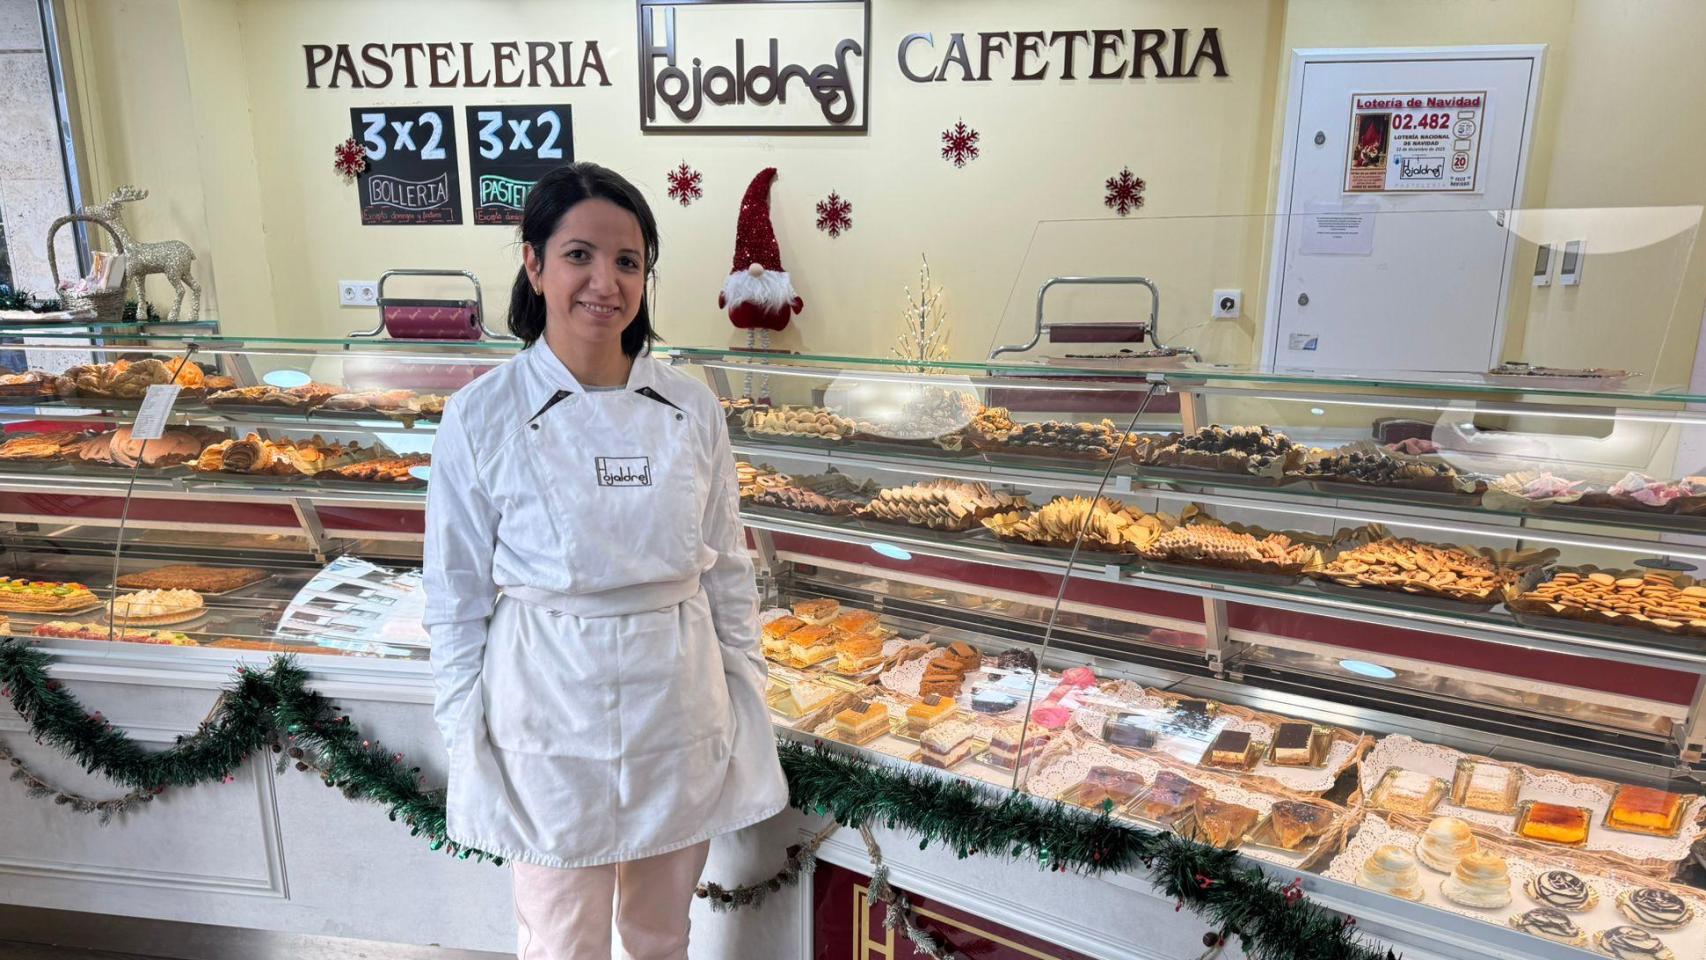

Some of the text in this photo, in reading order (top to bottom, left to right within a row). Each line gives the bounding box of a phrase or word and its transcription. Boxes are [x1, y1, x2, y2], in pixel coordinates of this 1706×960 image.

[302, 40, 613, 89] PASTELERIA
[645, 7, 862, 125] Hojaldres
[898, 27, 1230, 83] CAFETERIA
[1356, 96, 1481, 108] Lotería de Navidad
[1392, 113, 1450, 130] 02.482
[1455, 157, 1466, 167] 20
[372, 179, 447, 208] BOLLERIA
